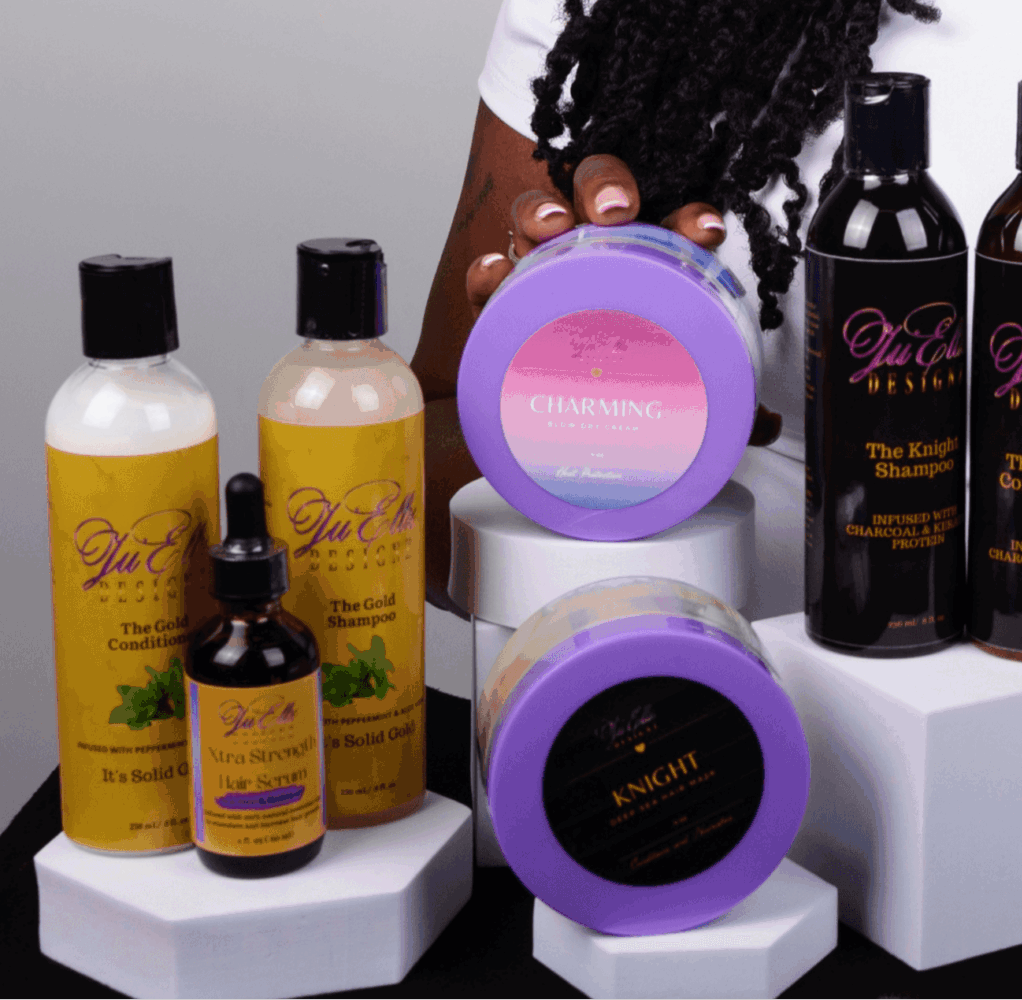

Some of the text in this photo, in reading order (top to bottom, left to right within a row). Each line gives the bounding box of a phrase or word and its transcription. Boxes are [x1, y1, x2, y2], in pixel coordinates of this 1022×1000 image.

[530, 394, 662, 420] CHARMING
[866, 436, 959, 459] The Knight
[875, 459, 954, 479] Shampoo
[872, 505, 958, 526] INFUSED WITH
[845, 524, 920, 538] CHARCOAL
[921, 524, 931, 535] &
[891, 532, 945, 550] PROTEIN
[330, 592, 396, 614] The Gold
[120, 614, 190, 636] The Gold
[327, 611, 397, 629] Shampoo
[107, 632, 188, 652] Condition
[344, 730, 385, 748] Solid
[208, 747, 246, 765] Xtra
[102, 768, 127, 783] It's
[131, 765, 174, 783] Solid
[219, 768, 308, 791] Hair Serum
[612, 750, 699, 808] KNIGHT
